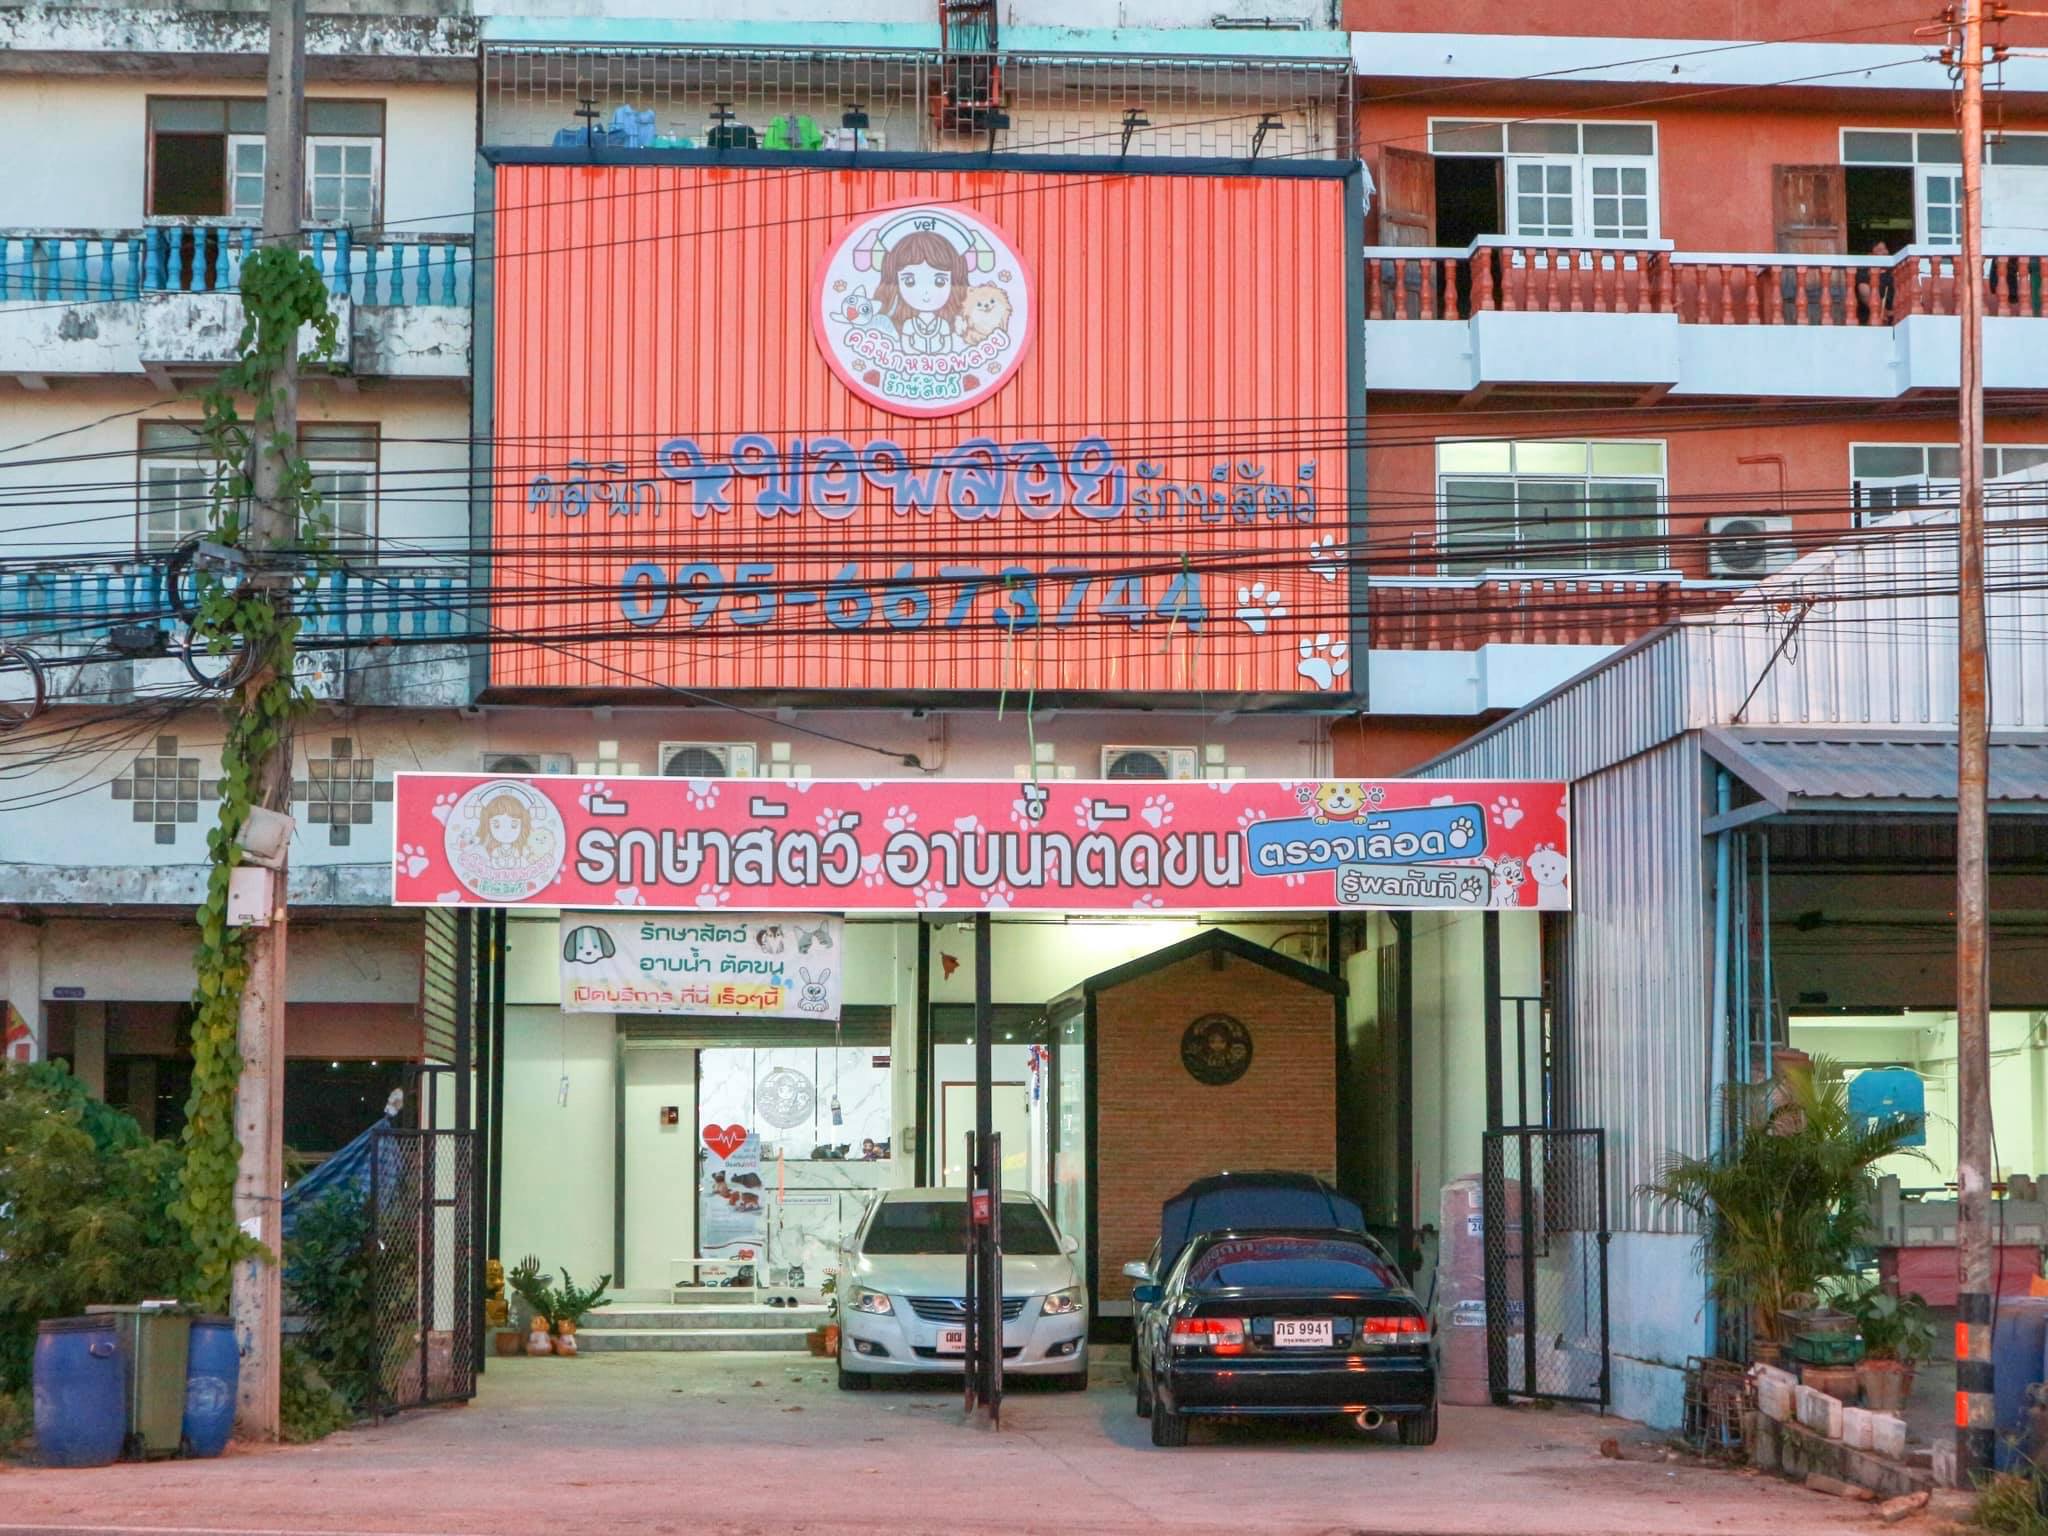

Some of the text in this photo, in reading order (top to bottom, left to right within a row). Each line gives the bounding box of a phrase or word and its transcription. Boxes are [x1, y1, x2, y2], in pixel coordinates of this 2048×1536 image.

[913, 217, 937, 231] vet
[847, 331, 1008, 373] คลินิกหมอพลอย
[528, 458, 662, 519] คลินิก
[655, 434, 1128, 522] หมอพลอย
[618, 560, 1209, 633] 095-6673744
[575, 783, 1244, 888] รักษาสัตว์ อาบน้ำตัดขน
[1258, 819, 1447, 868] ตรวจเลือด
[1341, 868, 1458, 903] รู้ผลทันที
[640, 921, 748, 943] รักษาสัตว์
[639, 946, 785, 976] อาบน้ำ ตัดขน
[574, 984, 780, 1010] เปิดบริการ ที่นี่ เร็วๆนี้
[1299, 1322, 1329, 1336] 9941
